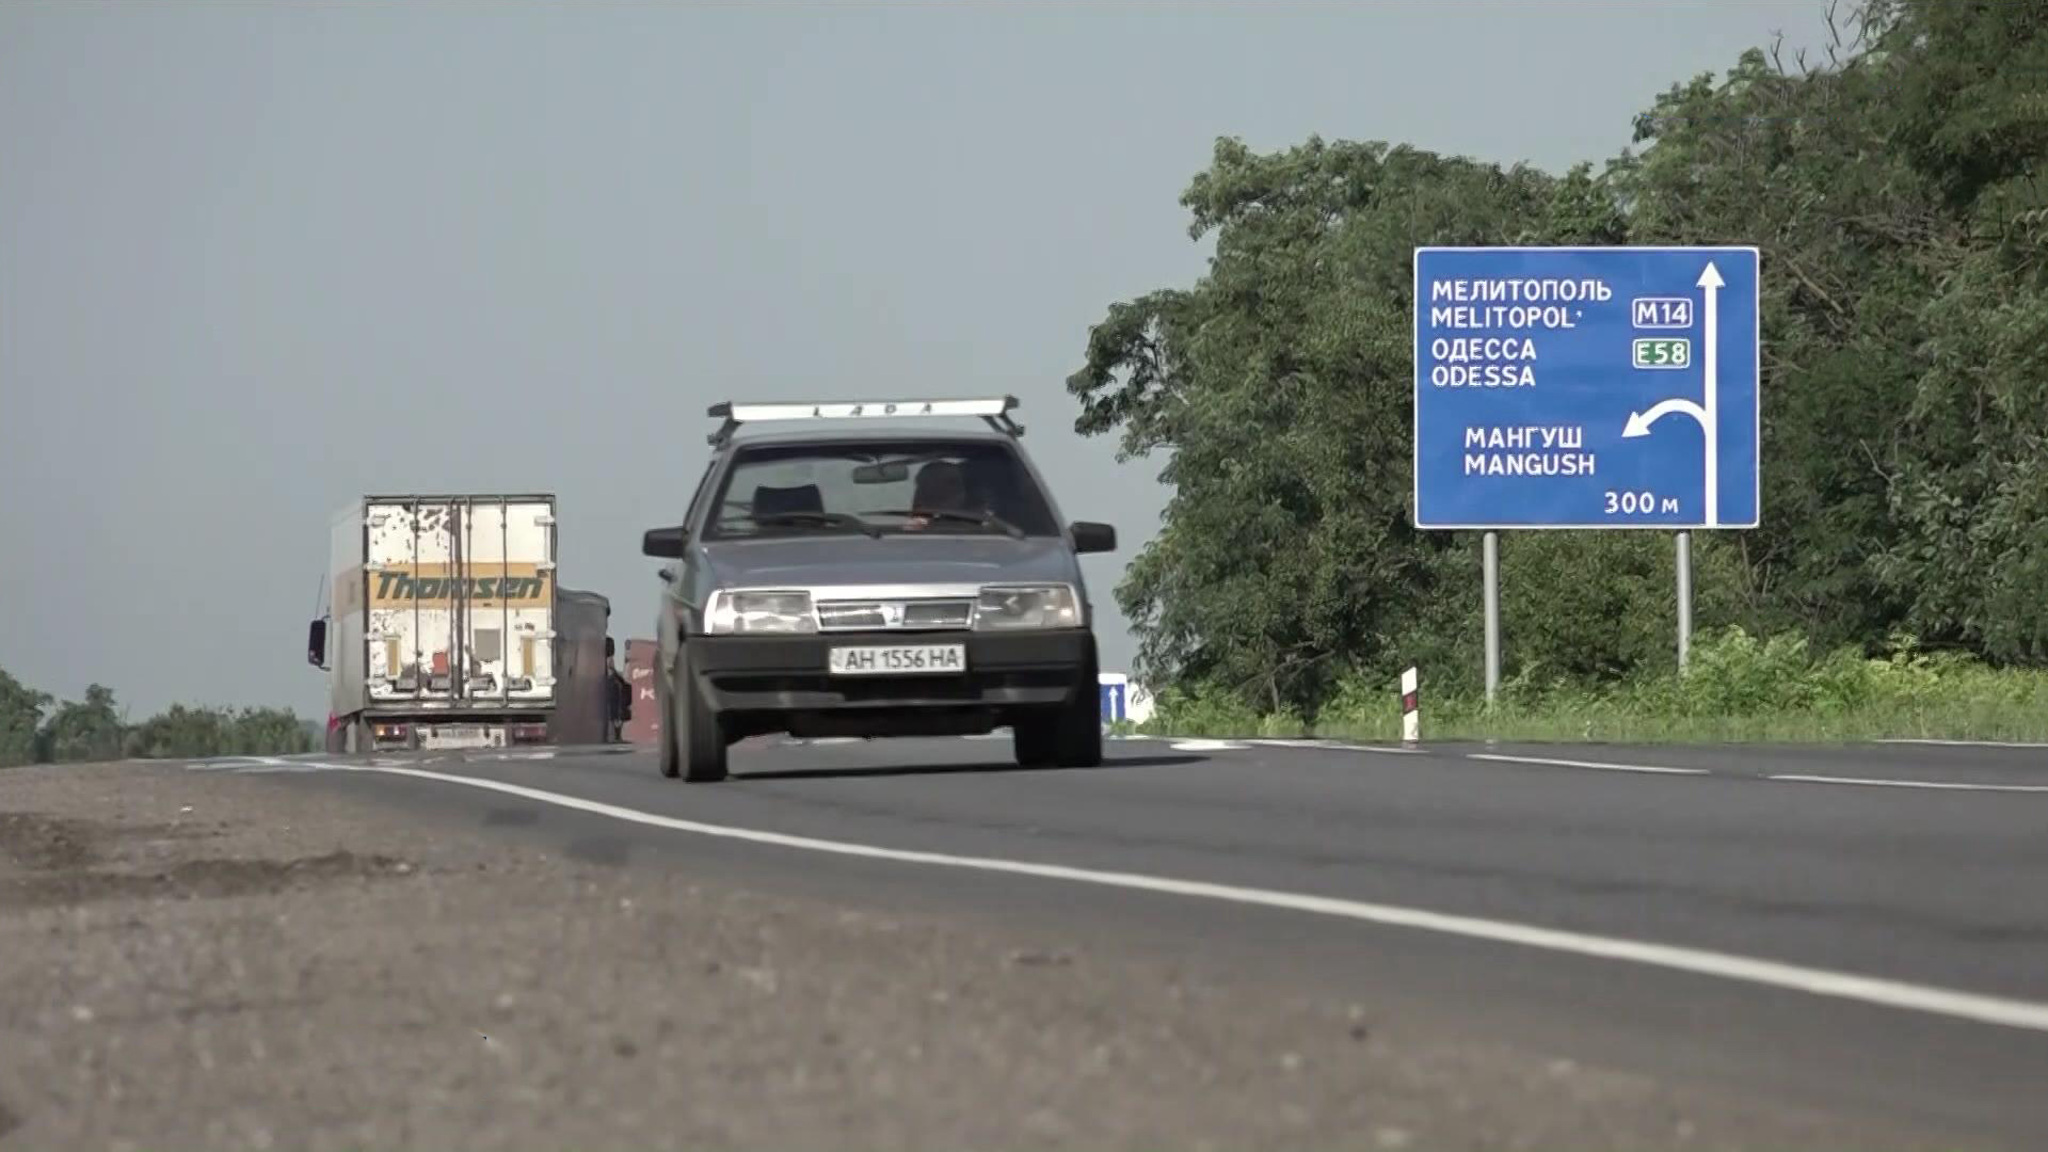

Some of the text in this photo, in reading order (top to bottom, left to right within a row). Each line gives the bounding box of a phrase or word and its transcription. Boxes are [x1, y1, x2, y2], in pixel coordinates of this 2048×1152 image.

[1432, 279, 1612, 301] МЕЛИТОПОЛЬ
[1431, 338, 1537, 363] ОДЕССА
[1637, 343, 1686, 364] E58
[1431, 365, 1537, 387] ODESSA
[1465, 427, 1582, 449] МАНГУШ
[1465, 454, 1595, 476] MANGUSH
[1605, 492, 1655, 514] 300
[881, 649, 925, 668] 1556
